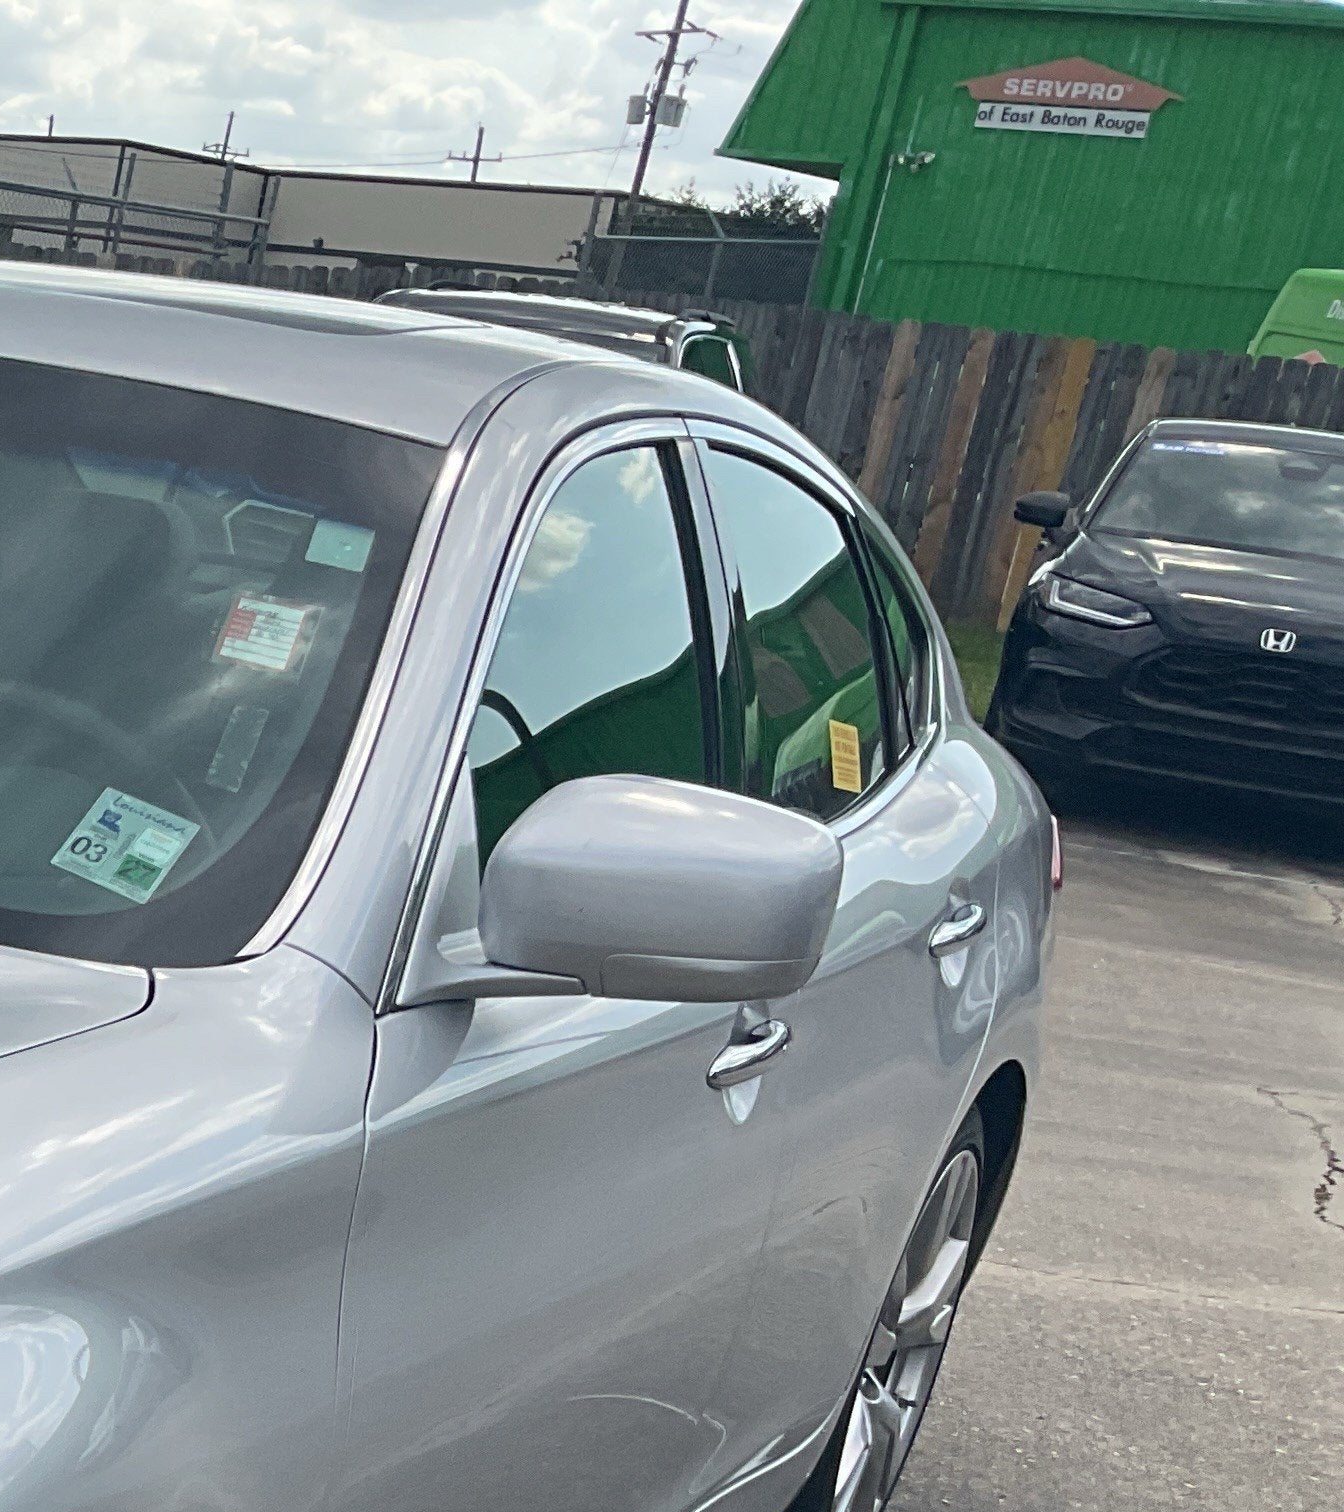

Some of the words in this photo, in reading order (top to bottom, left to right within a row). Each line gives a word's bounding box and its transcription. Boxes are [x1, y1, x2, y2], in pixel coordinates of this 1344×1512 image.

[1002, 77, 1126, 102] SERVPRO
[977, 105, 997, 122] of
[1000, 106, 1035, 124] East
[1040, 109, 1087, 128] Baton
[1094, 112, 1147, 135] Rouge
[70, 836, 108, 863] 03
